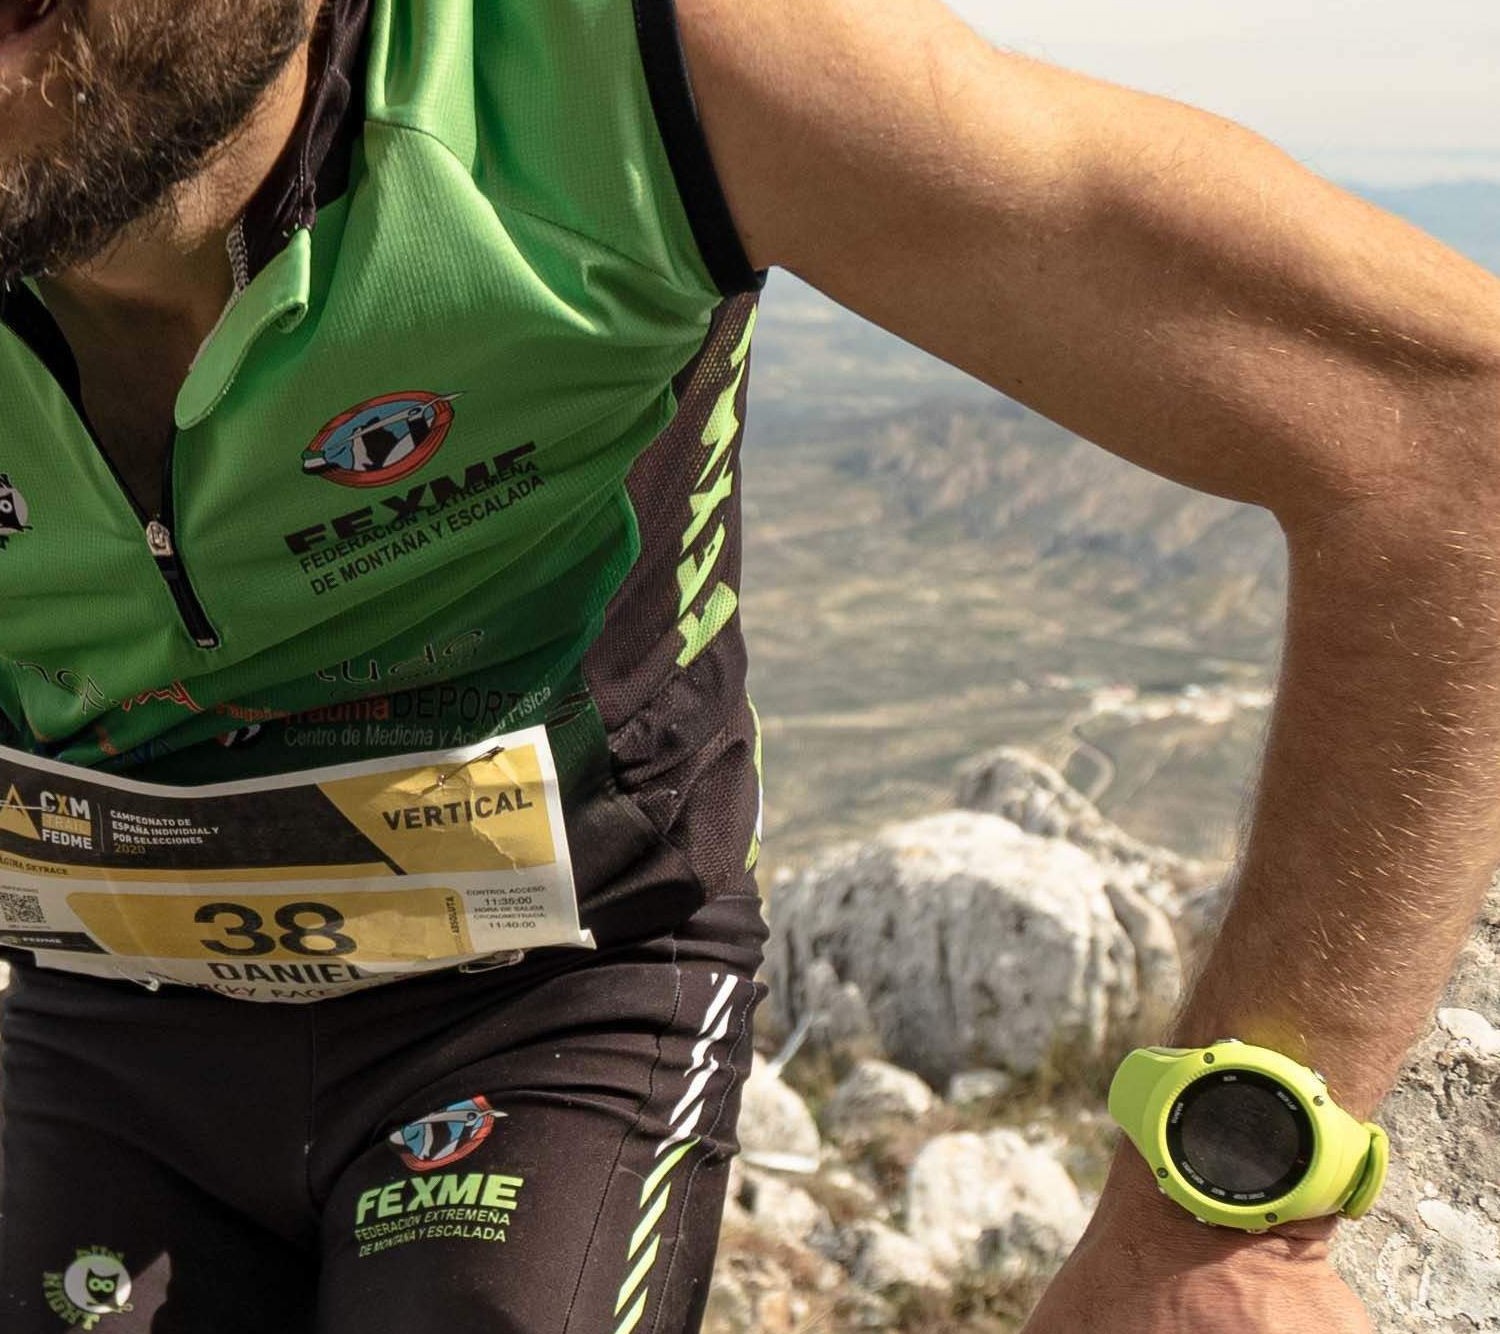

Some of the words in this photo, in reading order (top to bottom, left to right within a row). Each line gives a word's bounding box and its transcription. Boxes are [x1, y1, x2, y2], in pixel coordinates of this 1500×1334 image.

[311, 574, 339, 595] DE
[341, 528, 431, 584] MONTAÑA
[431, 522, 443, 539] Y
[450, 475, 545, 532] ESCALADA
[285, 727, 337, 748] Centro
[341, 725, 360, 746] de
[365, 724, 433, 747] Medicina
[438, 731, 449, 749] y
[39, 790, 91, 820] CXM
[382, 788, 533, 830] VERTICAL
[110, 810, 176, 827] CAMPEONATO
[177, 818, 192, 827] DE
[112, 820, 149, 835] ESPAÑA
[151, 827, 210, 836] INDIVIDUAL
[211, 826, 219, 835] Y
[42, 830, 93, 850] FEDME
[112, 832, 133, 843] POR
[134, 835, 203, 845] SELECCIONES
[114, 843, 146, 854] 2020
[194, 902, 357, 956] 38
[207, 962, 364, 984] DANIEL
[356, 1173, 524, 1225] FEXME
[424, 1208, 511, 1226] EXTREMEÑA
[359, 1244, 373, 1257] DE
[418, 1228, 427, 1240] Y
[427, 1225, 506, 1242] ESCALADA
